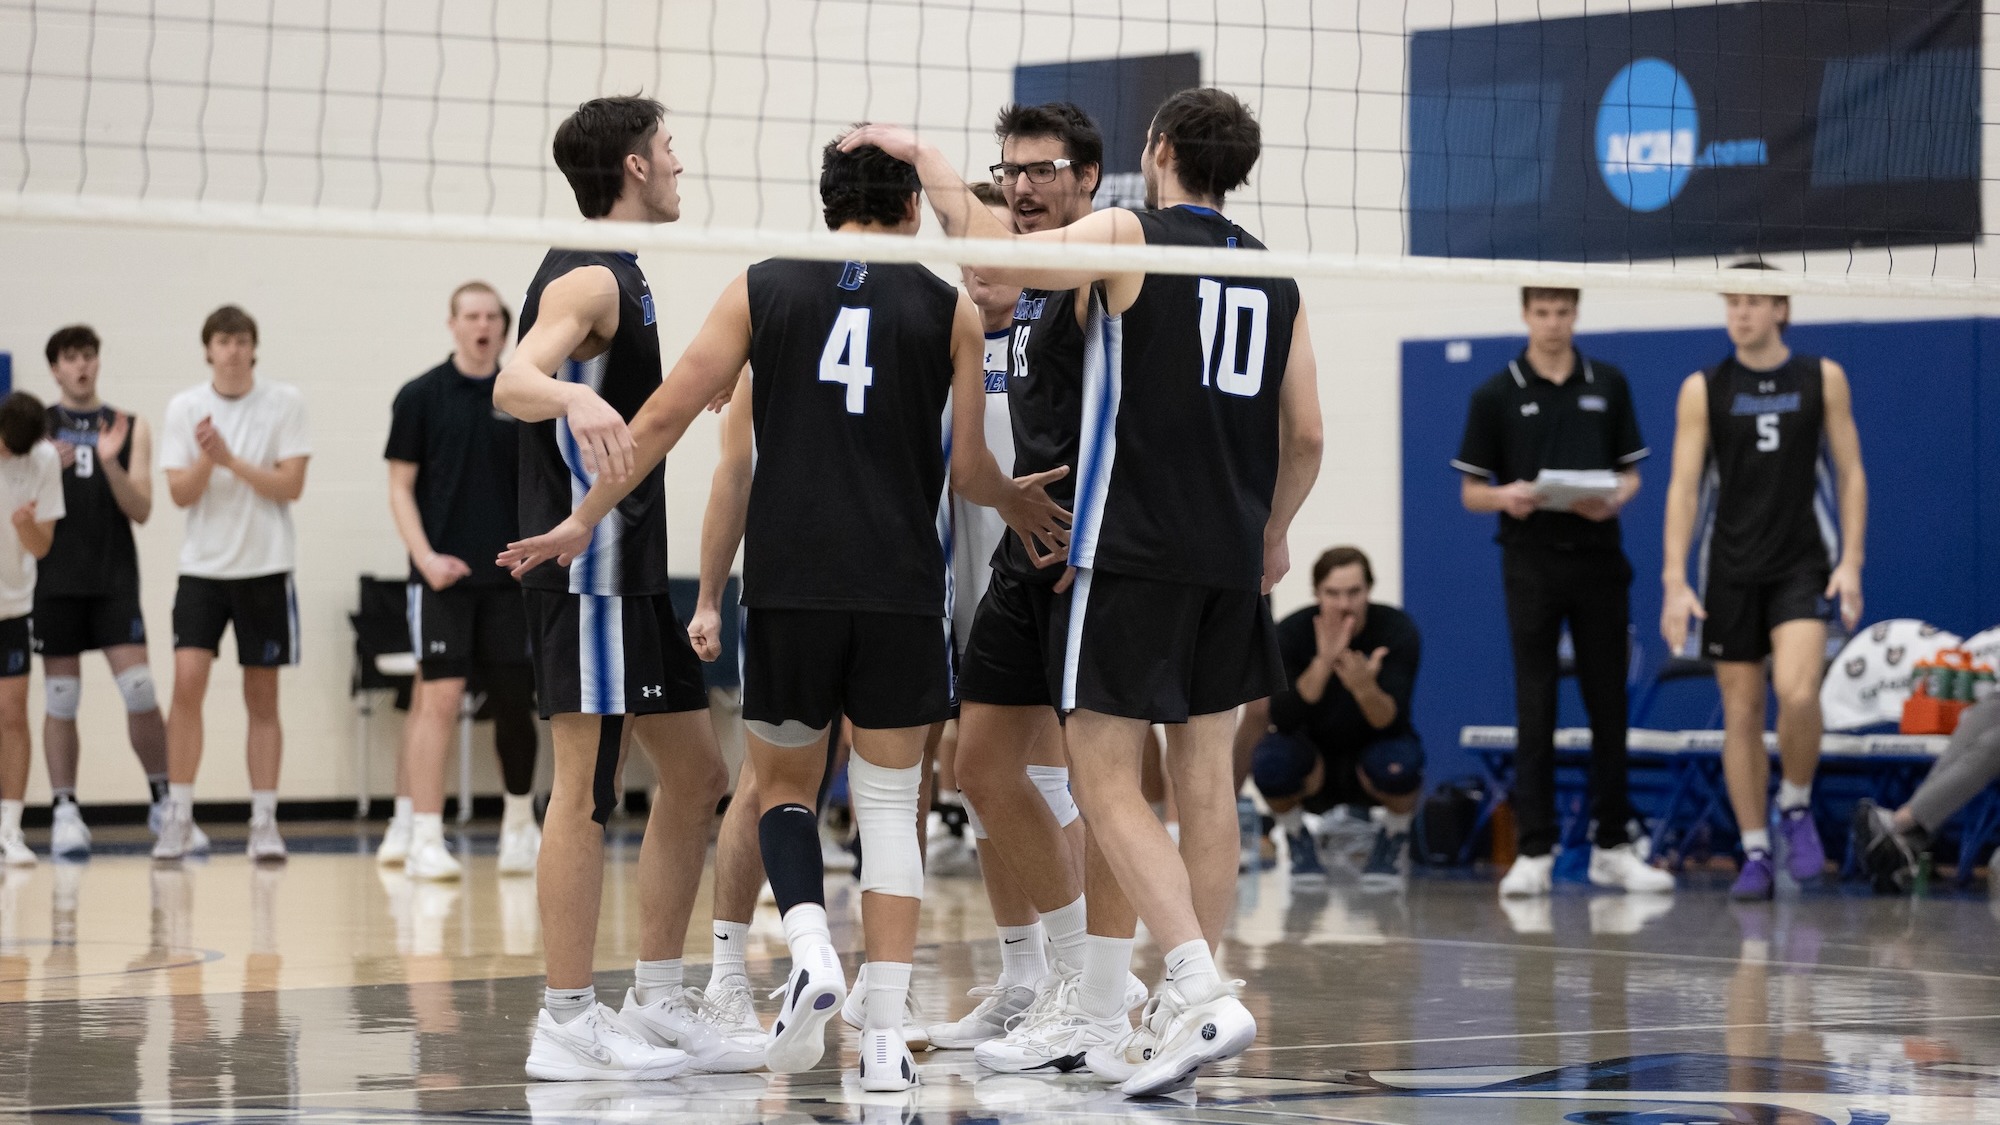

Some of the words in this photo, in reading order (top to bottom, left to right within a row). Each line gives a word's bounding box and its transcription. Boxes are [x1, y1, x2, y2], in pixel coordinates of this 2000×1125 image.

[818, 306, 874, 415] 4
[1012, 325, 1031, 377] 18
[1198, 277, 1270, 398] 10
[1756, 412, 1780, 452] 5
[75, 445, 94, 478] 9
